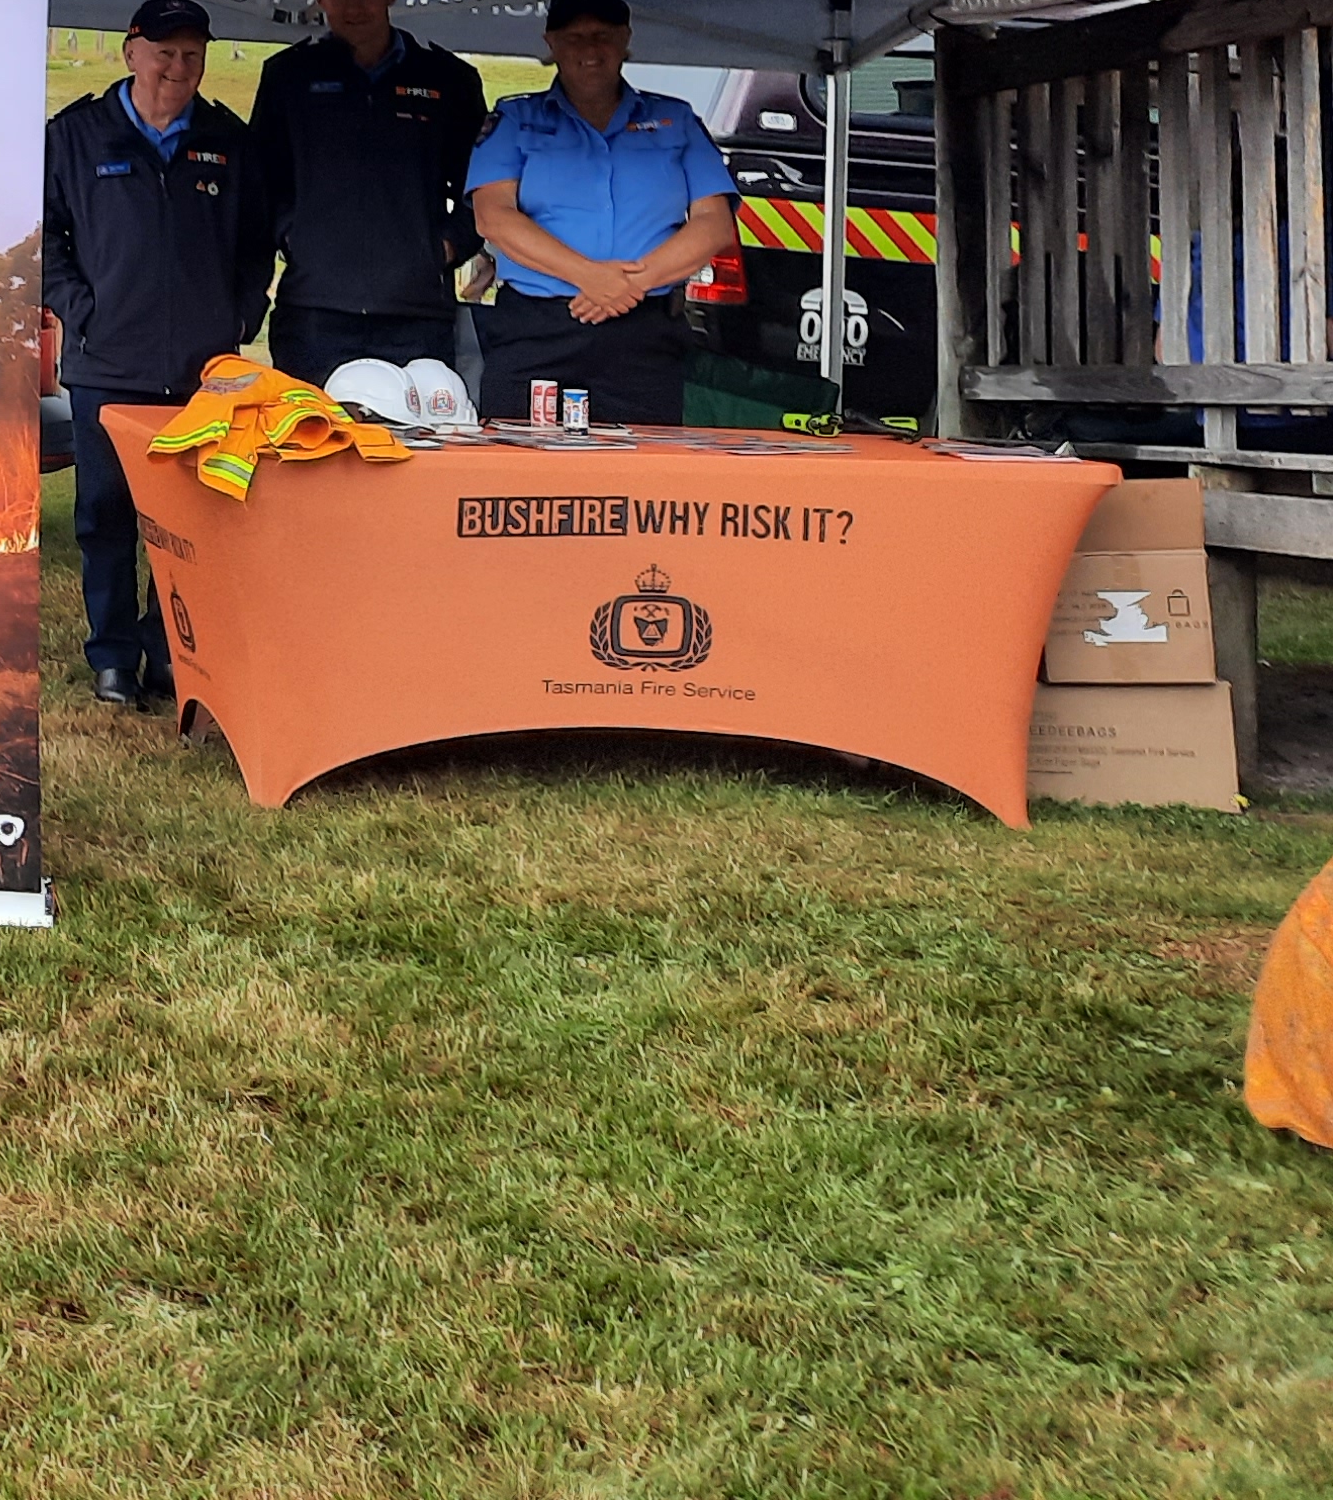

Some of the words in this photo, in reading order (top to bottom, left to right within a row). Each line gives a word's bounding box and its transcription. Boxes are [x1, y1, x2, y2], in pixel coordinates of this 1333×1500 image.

[800, 311, 868, 348] 00
[461, 498, 625, 535] BUSHFIRE
[634, 500, 710, 536] WHY
[720, 502, 792, 541] RISK
[802, 507, 854, 545] IT?
[541, 679, 633, 695] Tasmania
[641, 681, 676, 696] Fire
[683, 682, 756, 701] Service
